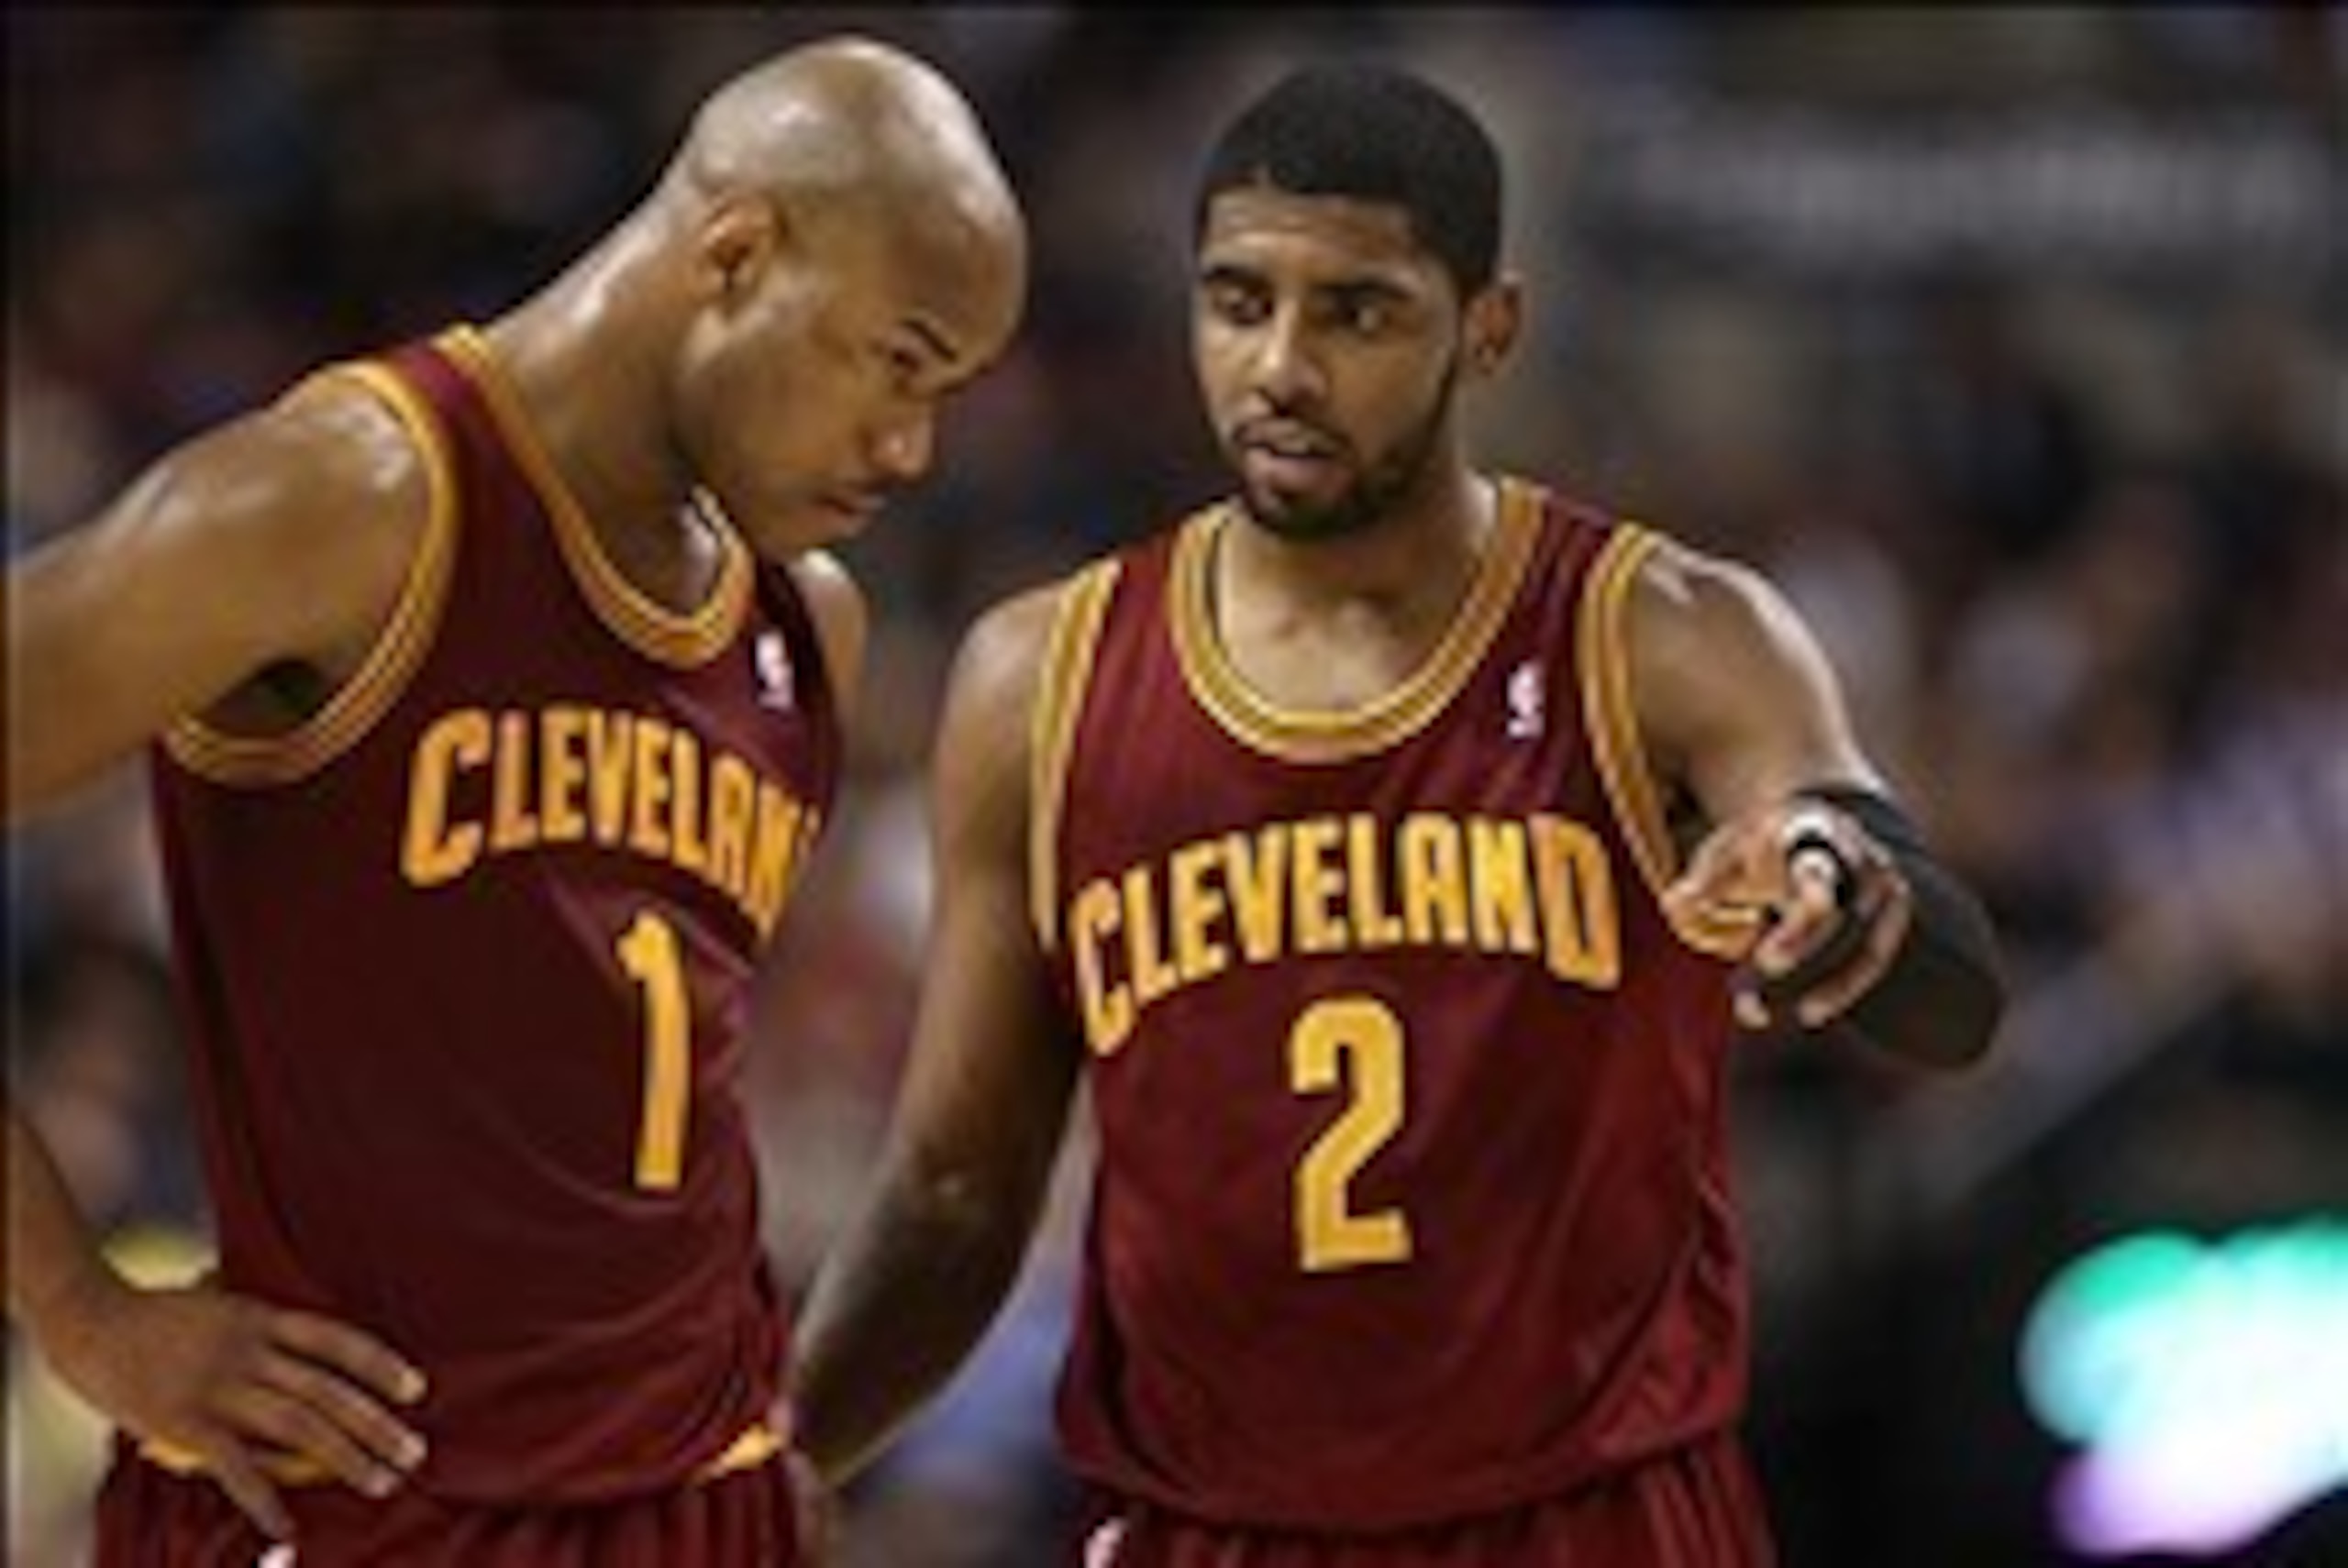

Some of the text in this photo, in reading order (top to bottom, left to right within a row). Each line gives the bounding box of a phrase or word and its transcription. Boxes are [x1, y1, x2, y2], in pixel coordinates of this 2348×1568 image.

[401, 706, 822, 939] CLEVELAN
[1069, 812, 1620, 1055] CLEVELAND
[616, 911, 690, 1188] 1
[1289, 997, 1411, 1273] 2
